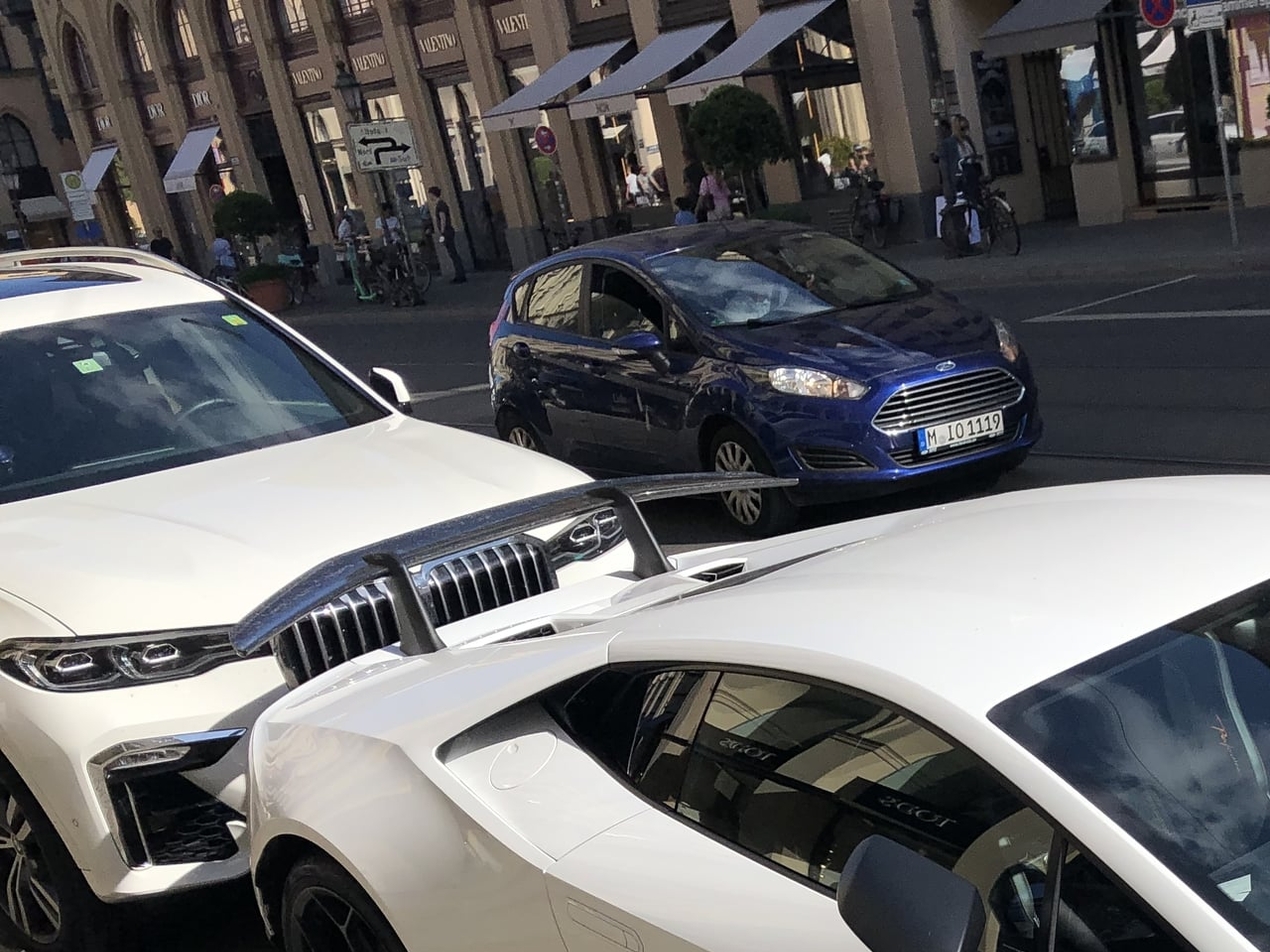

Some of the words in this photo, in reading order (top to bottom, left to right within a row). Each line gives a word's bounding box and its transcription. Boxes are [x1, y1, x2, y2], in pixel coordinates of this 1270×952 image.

[496, 13, 529, 35] VALENTI
[927, 428, 938, 447] M
[967, 413, 1001, 436] 1119
